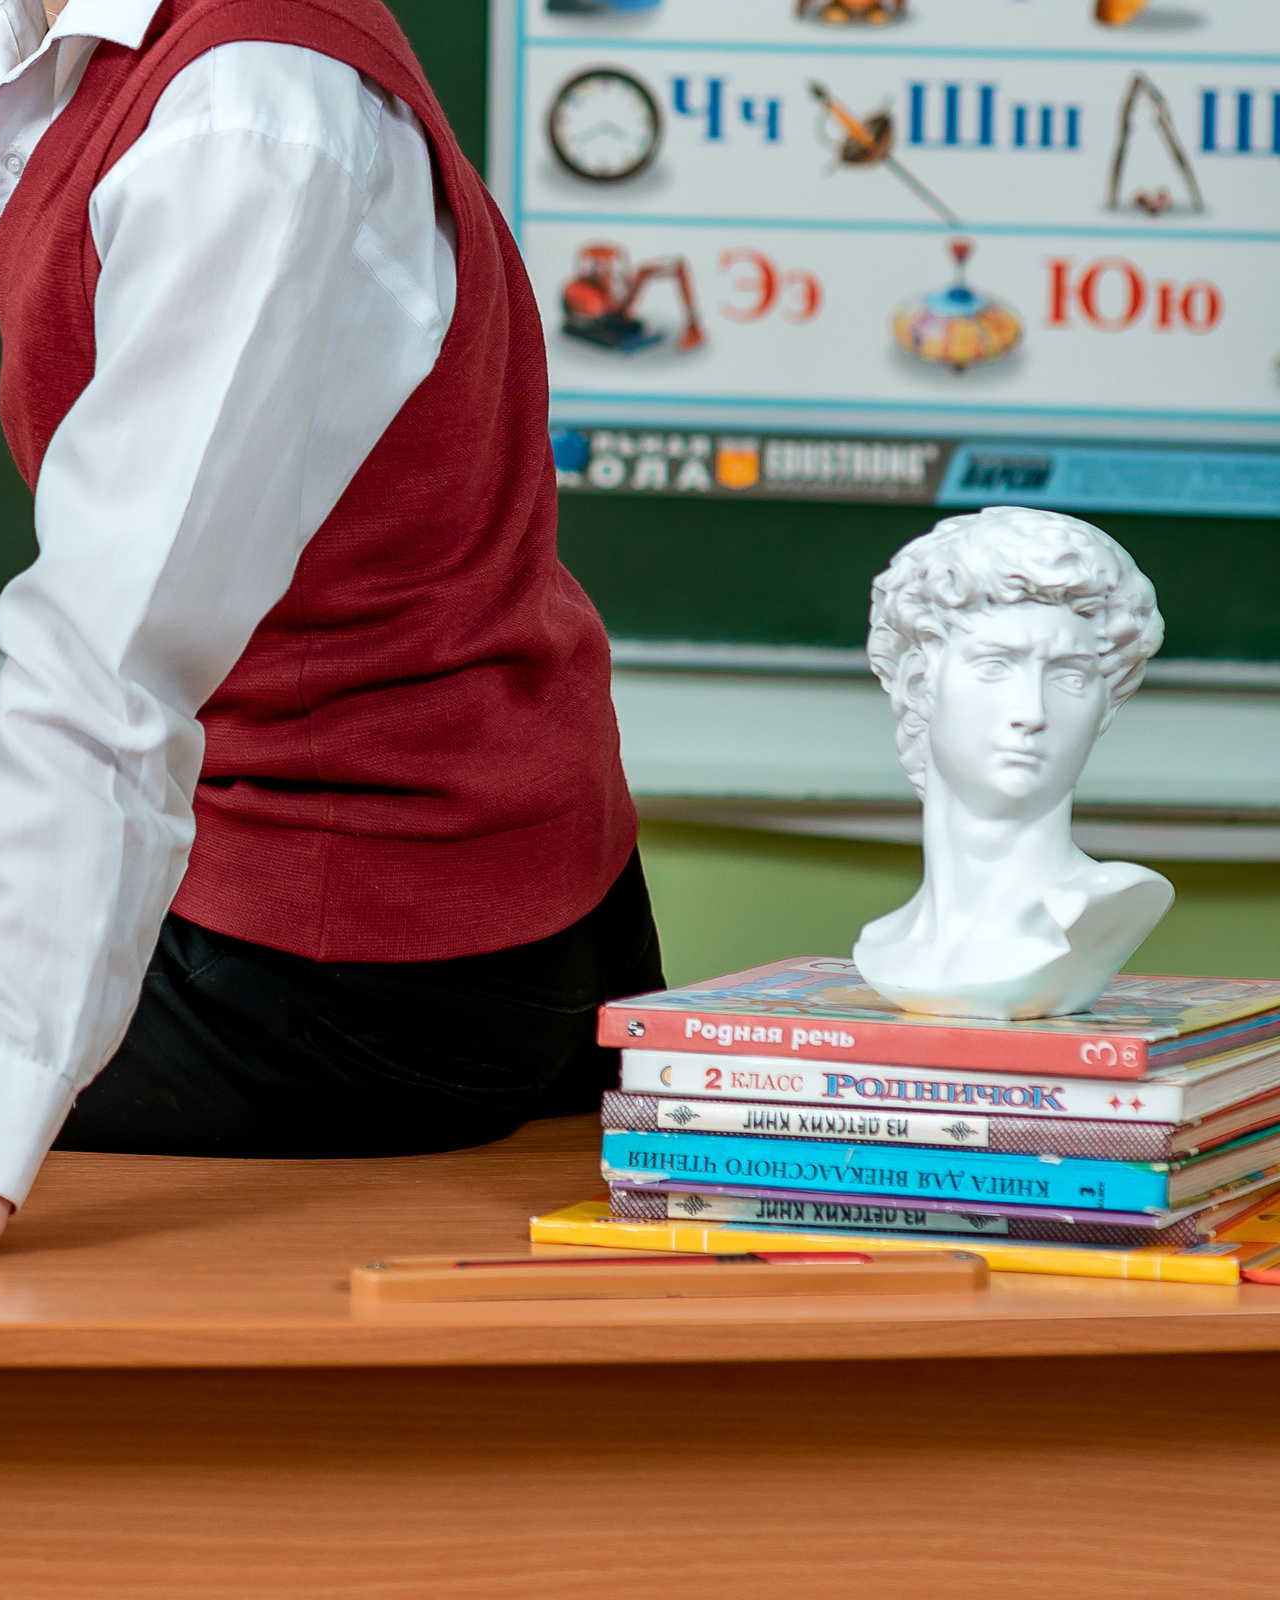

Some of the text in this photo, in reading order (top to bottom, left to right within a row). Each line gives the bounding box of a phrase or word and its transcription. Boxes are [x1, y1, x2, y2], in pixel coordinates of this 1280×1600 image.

[671, 77, 783, 145] Чч
[907, 83, 1084, 152] Шш
[718, 249, 1225, 334] Ээ Юю
[685, 1018, 855, 1050] Родная речь
[1081, 1040, 1117, 1068] 3
[704, 1068, 1068, 1114] 2 КЛАСС РОДНИЧОК
[743, 1109, 909, 1138] ИЗ ДЕТСКИХ КНИГ
[628, 1150, 1050, 1199] КНИГА ДЛЯ ВНЕКЛАССНОГО ЧТЕНИЯ
[1080, 1186, 1097, 1198] 3
[756, 1199, 927, 1227] ИЗ ДЕТСКИХ КНИГ
